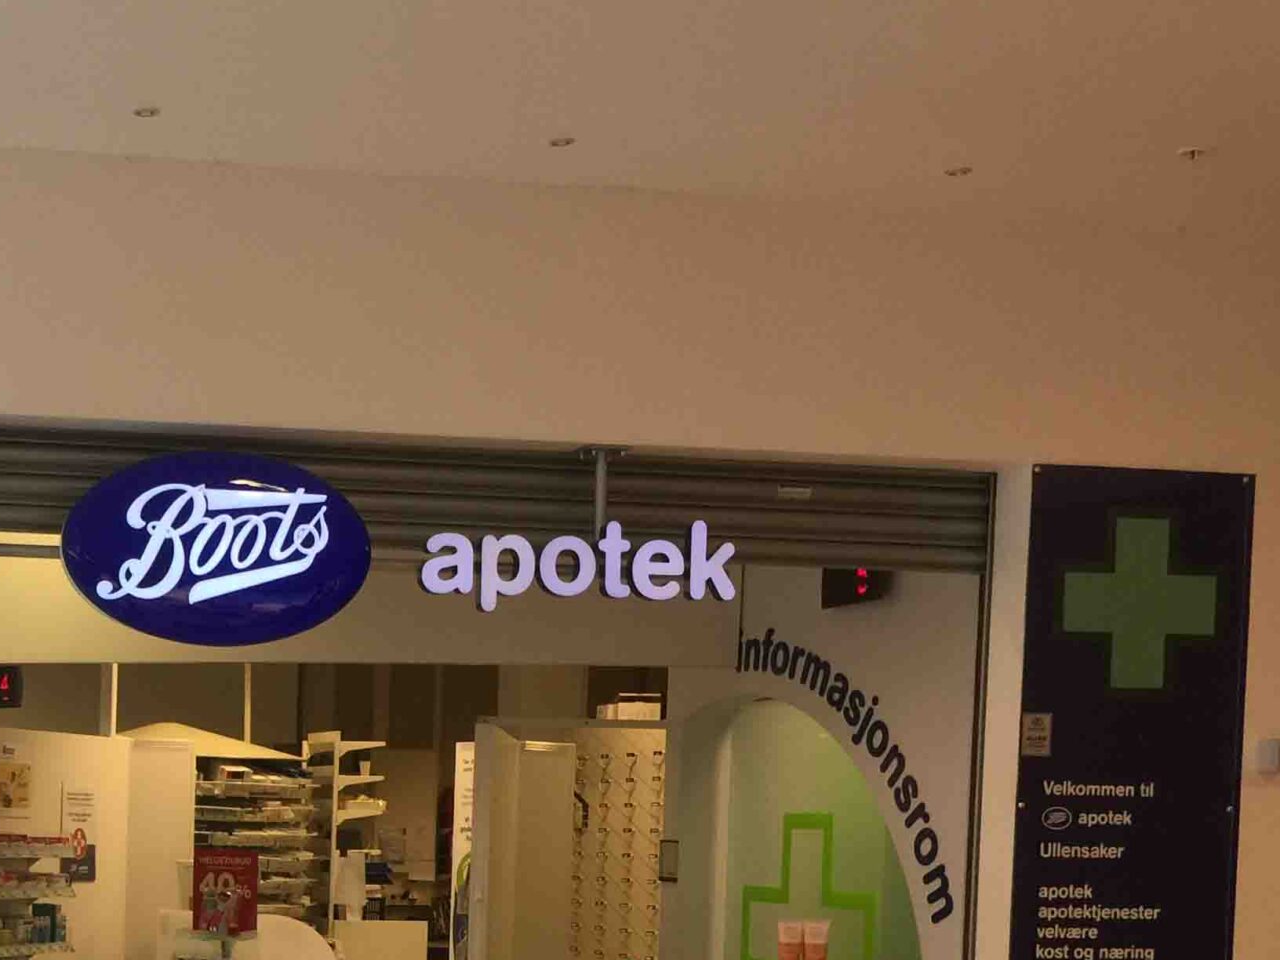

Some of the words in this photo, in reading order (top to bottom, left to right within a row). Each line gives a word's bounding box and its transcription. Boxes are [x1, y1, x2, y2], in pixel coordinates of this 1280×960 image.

[96, 482, 329, 605] Boots
[421, 520, 736, 612] apotek
[735, 627, 955, 925] informasjonsrom
[1043, 780, 1135, 798] Velkommen
[1140, 782, 1154, 798] til
[1078, 810, 1133, 828] apotek
[1040, 842, 1126, 859] Ullensaker
[1038, 884, 1093, 901] apotek
[1038, 903, 1161, 922] apotektjenester
[1037, 924, 1098, 939] velvære
[1035, 943, 1069, 959] kost
